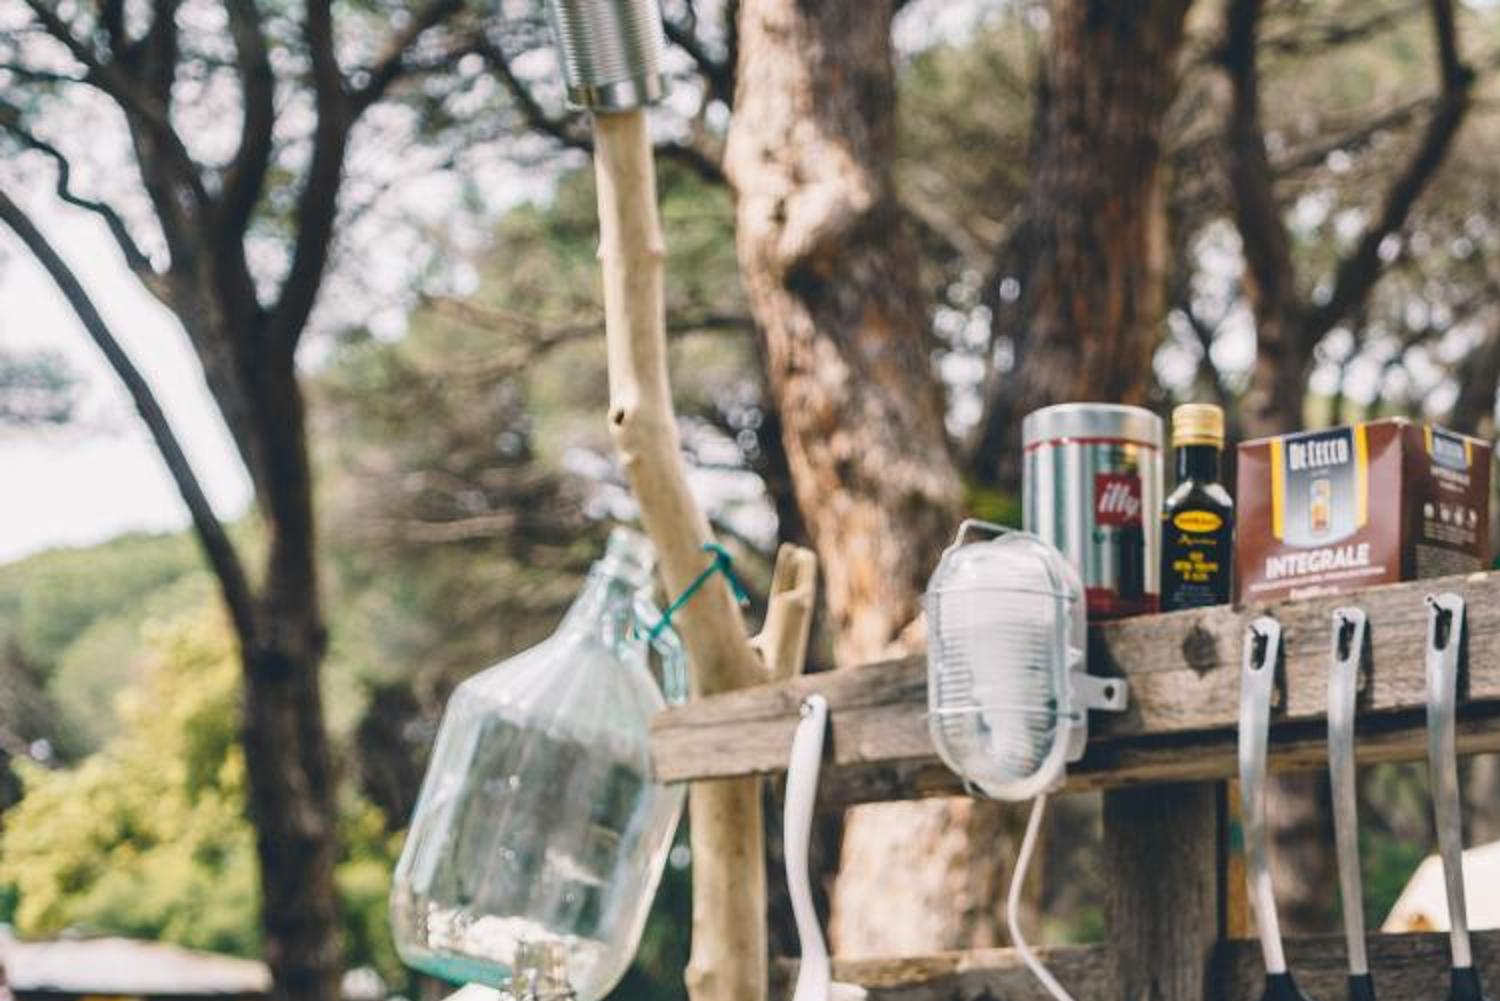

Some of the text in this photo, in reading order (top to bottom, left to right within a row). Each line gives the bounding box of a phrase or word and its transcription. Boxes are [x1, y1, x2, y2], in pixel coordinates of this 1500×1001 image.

[1307, 438, 1348, 467] CECCO
[1099, 481, 1139, 519] illy
[1265, 543, 1370, 579] INTEGRALE
